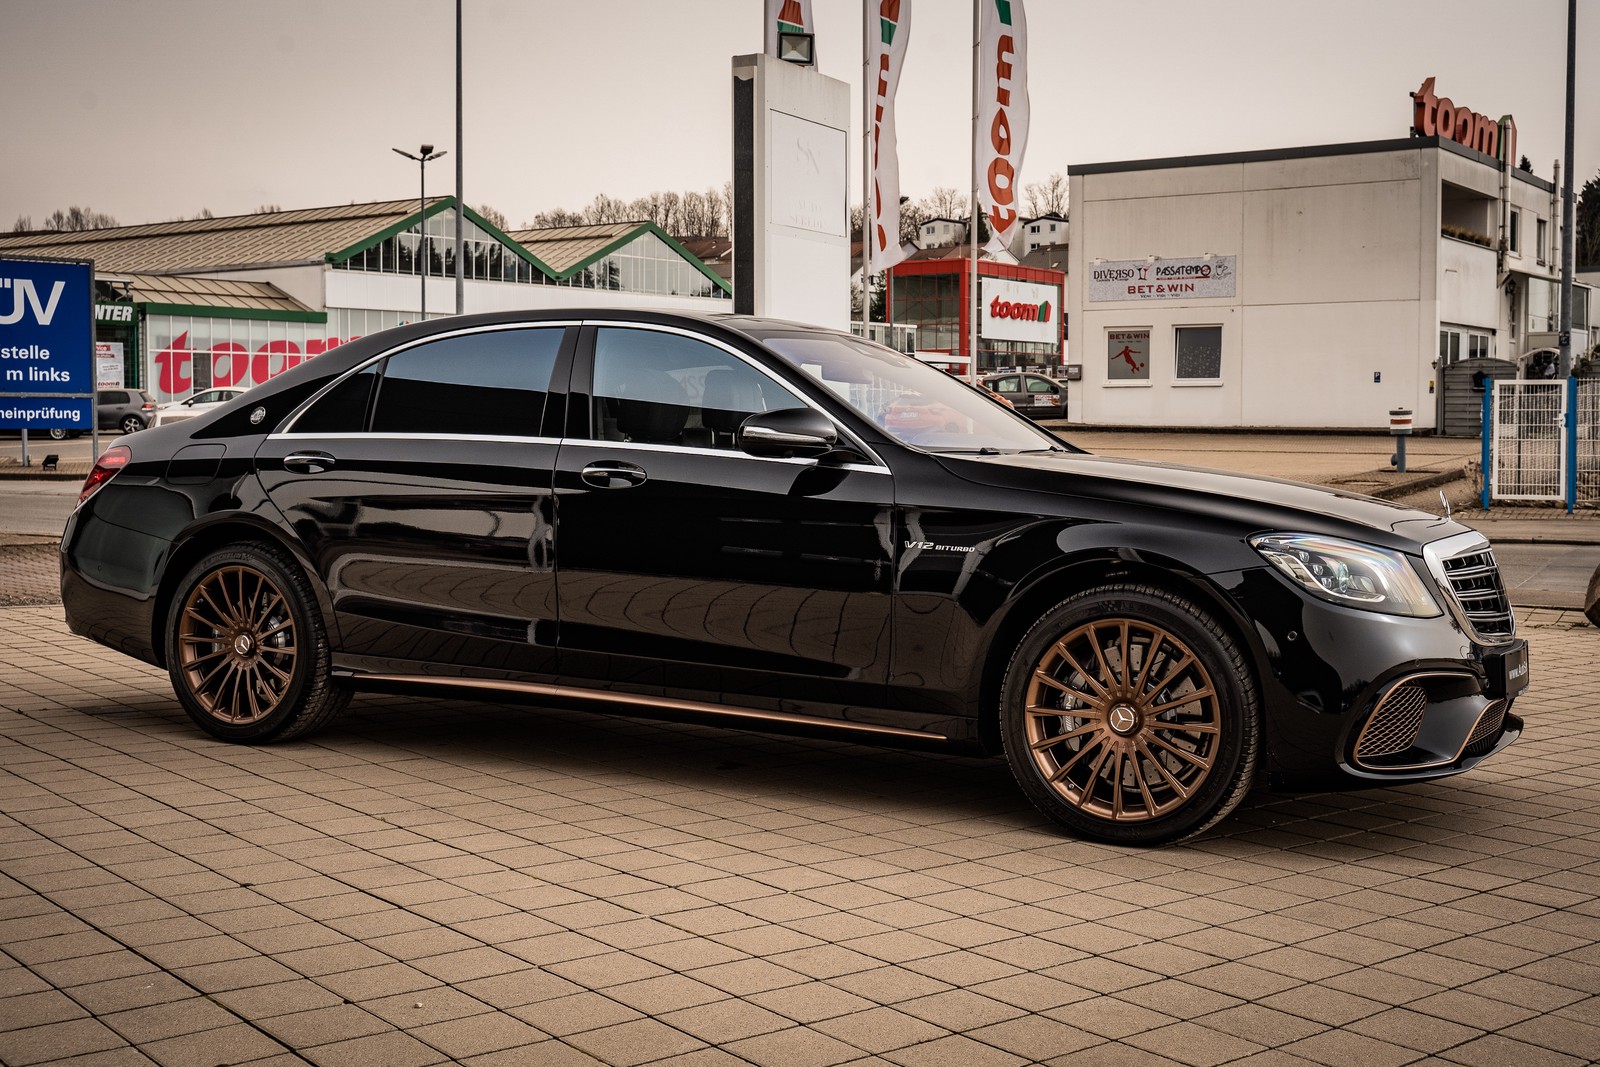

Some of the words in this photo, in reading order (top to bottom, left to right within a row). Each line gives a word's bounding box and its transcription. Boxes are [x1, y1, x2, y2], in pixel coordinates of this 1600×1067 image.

[1415, 77, 1498, 158] toom
[1093, 269, 1134, 280] DIVERSO
[1156, 264, 1211, 276] PASSATEMPO
[990, 295, 1039, 321] toom
[1, 345, 50, 360] stelle
[7, 370, 23, 381] m
[29, 367, 70, 382] links
[904, 541, 934, 550] V12
[935, 545, 975, 553] BITURBO
